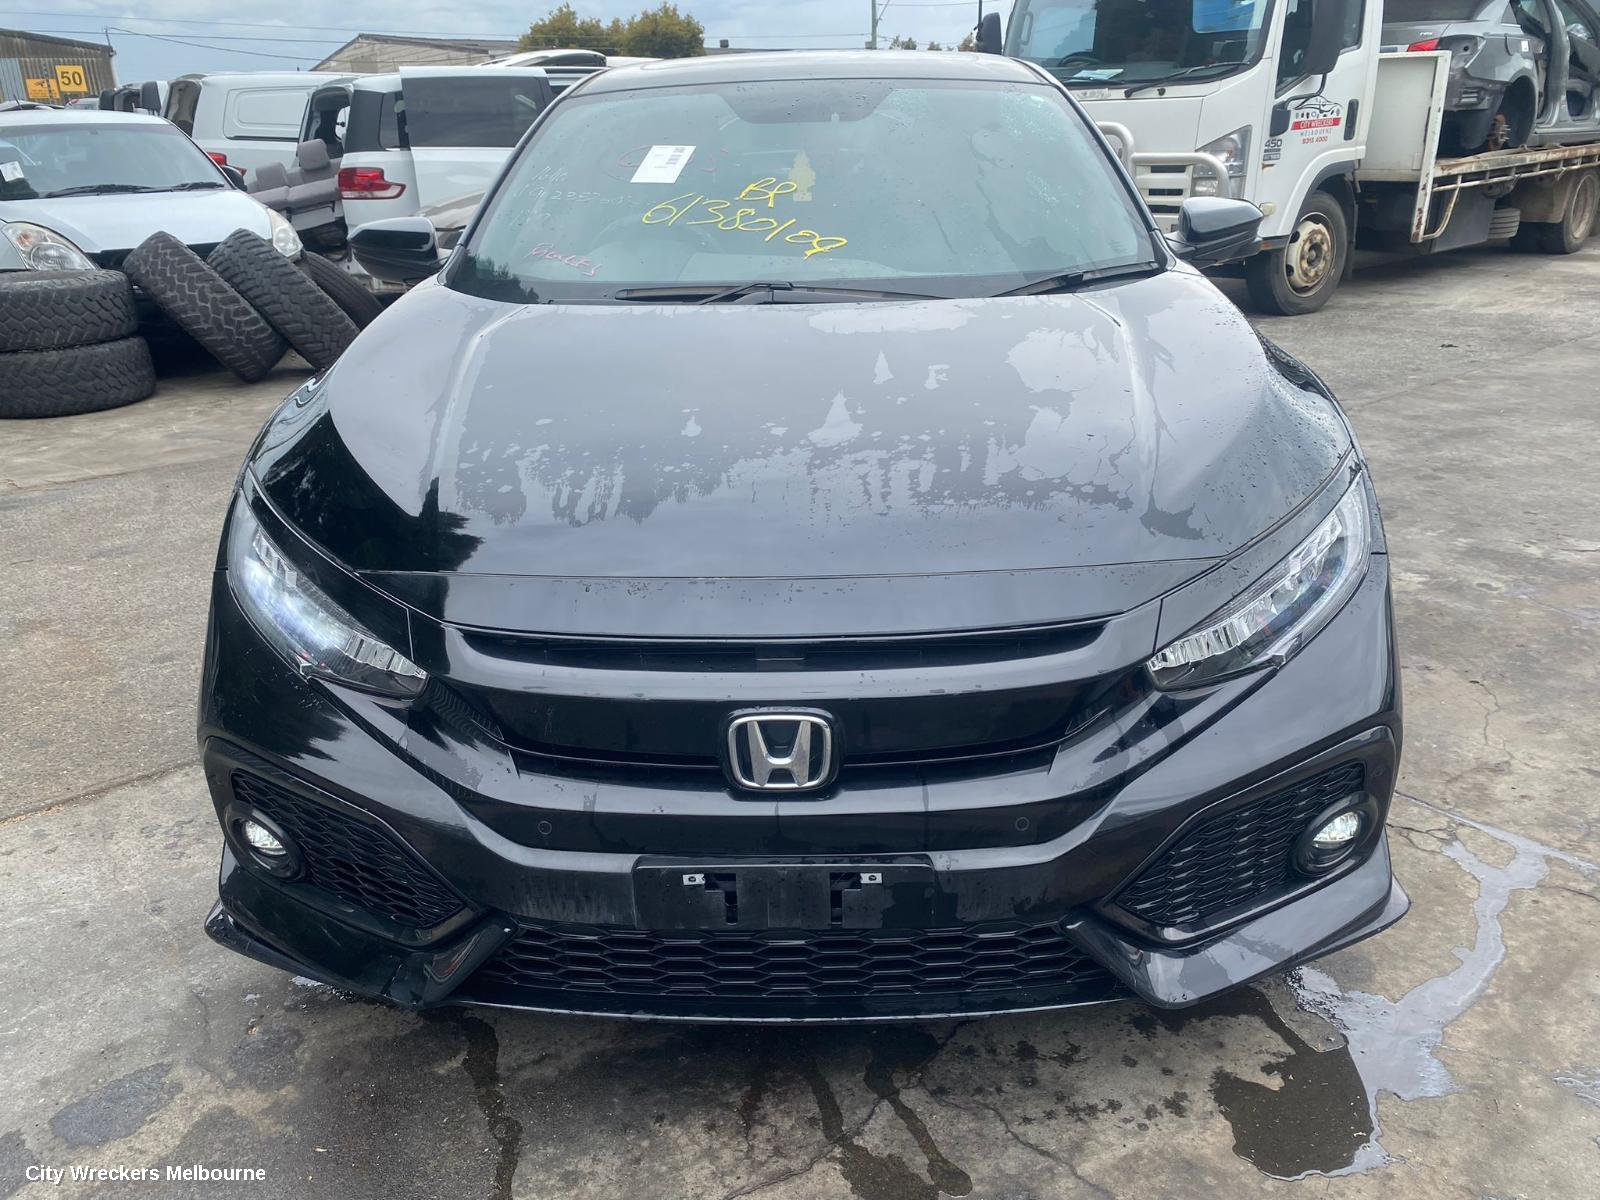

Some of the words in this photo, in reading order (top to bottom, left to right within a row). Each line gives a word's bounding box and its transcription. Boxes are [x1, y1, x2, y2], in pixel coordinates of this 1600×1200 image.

[61, 71, 82, 86] 50
[1300, 121, 1311, 129] CITY
[1265, 139, 1282, 148] 450
